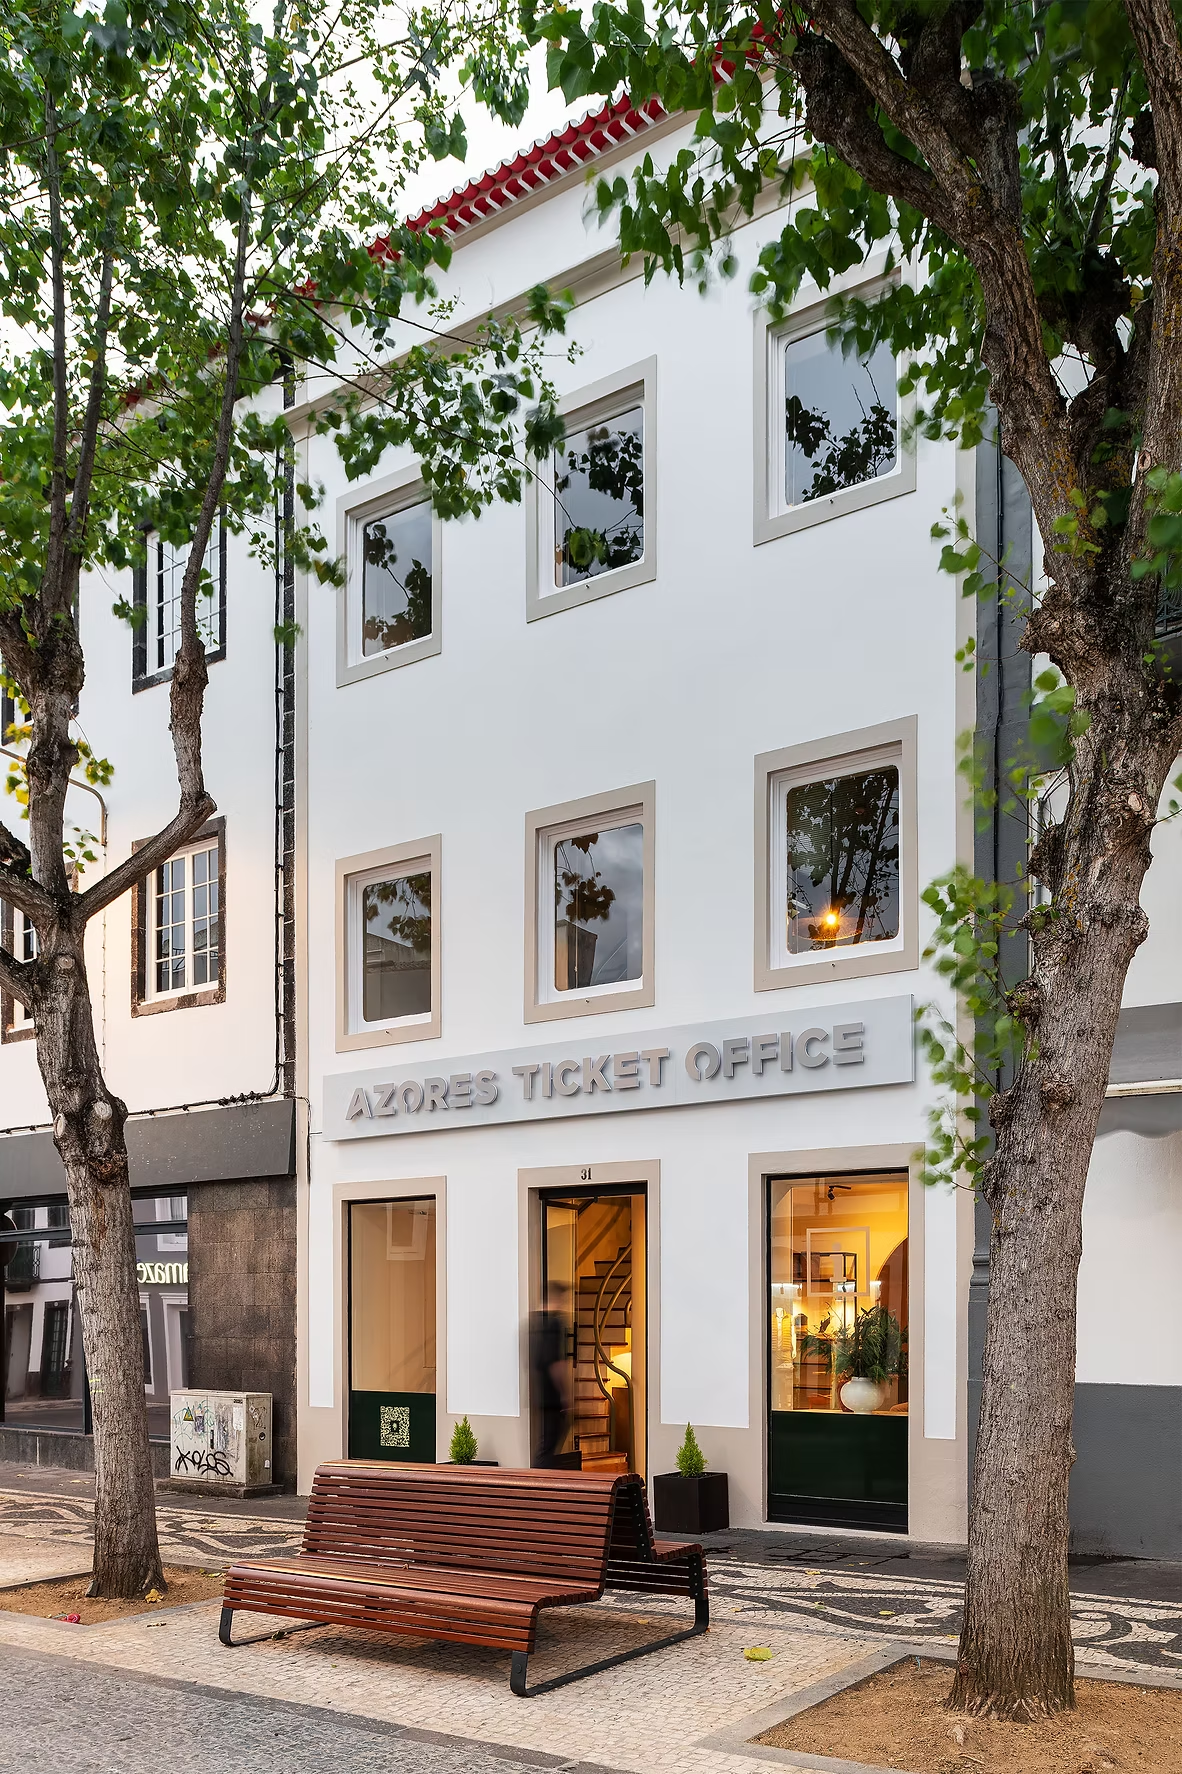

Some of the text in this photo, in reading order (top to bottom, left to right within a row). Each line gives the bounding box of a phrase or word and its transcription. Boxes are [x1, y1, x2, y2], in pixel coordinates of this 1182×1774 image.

[345, 1021, 865, 1120] AZORES TICKET OFFICE
[580, 1167, 592, 1181] 31
